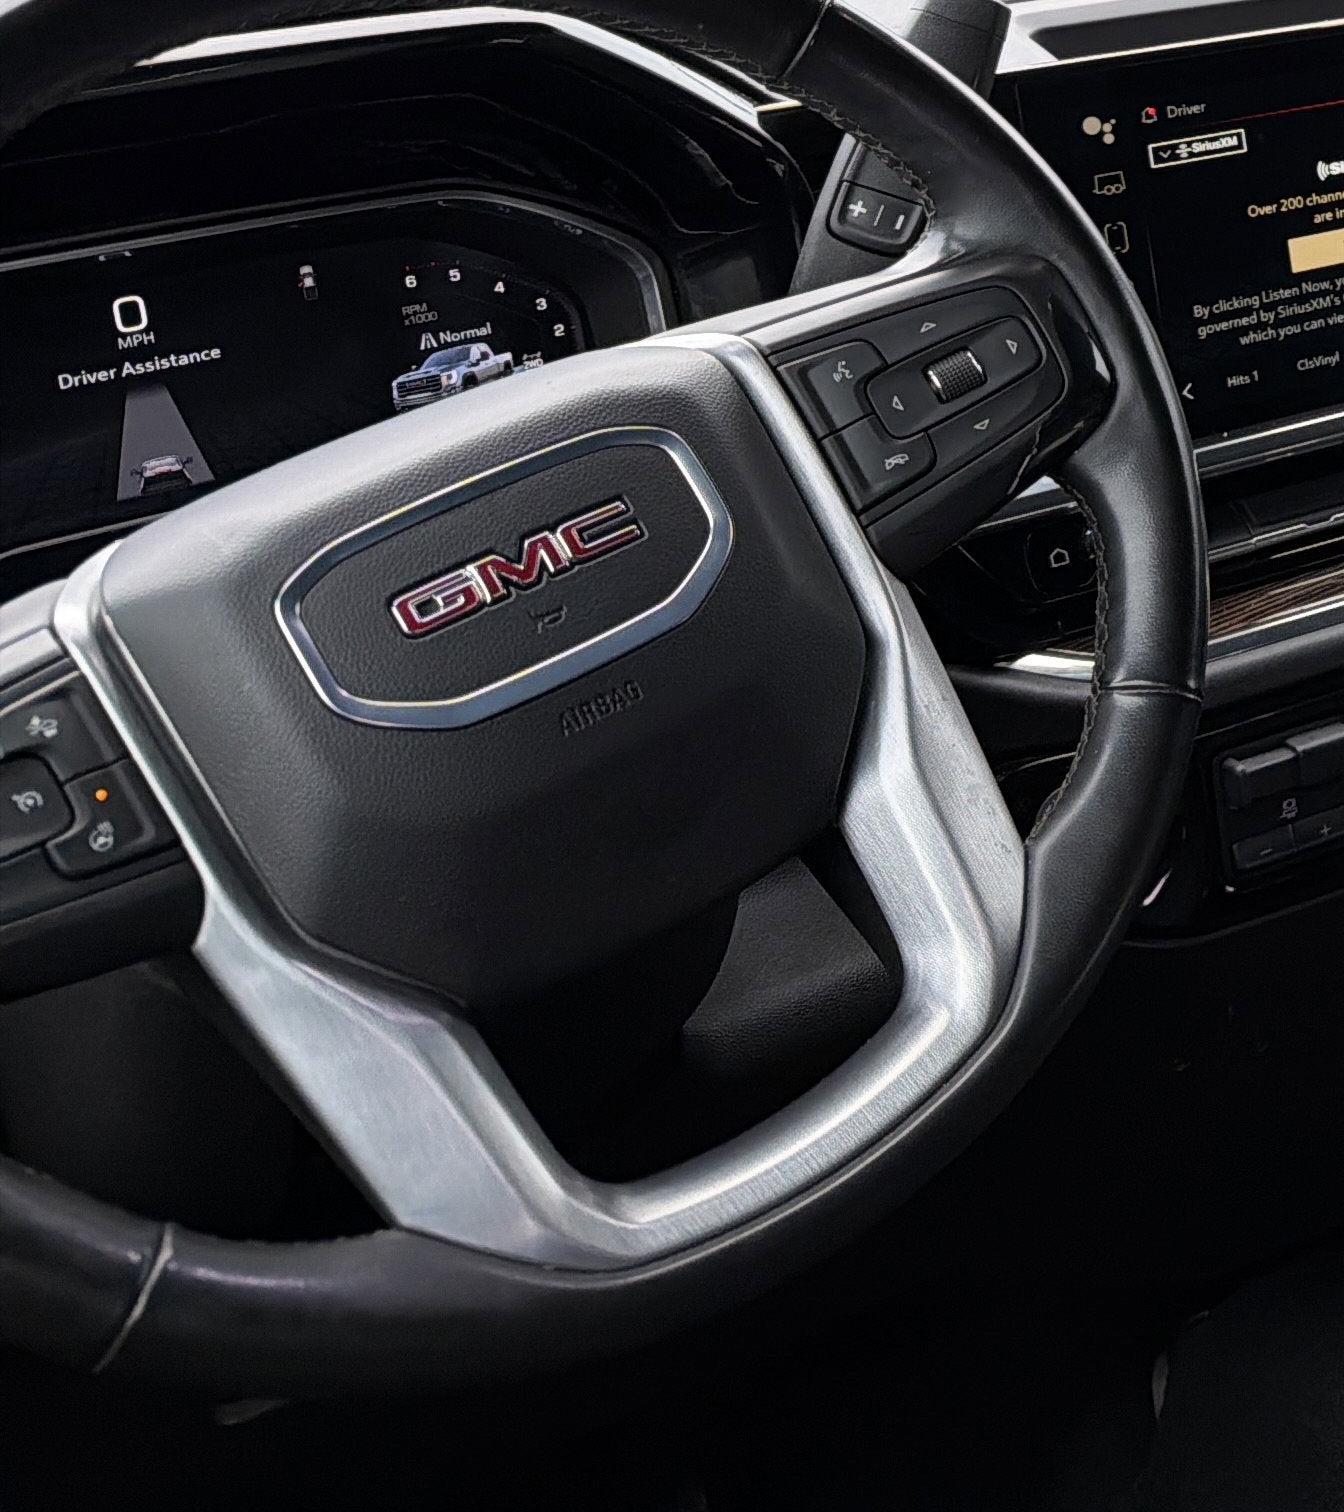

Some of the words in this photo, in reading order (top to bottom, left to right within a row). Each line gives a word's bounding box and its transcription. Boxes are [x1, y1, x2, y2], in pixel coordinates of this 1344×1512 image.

[1166, 104, 1206, 119] Driver
[1247, 202, 1277, 218] Over
[1280, 196, 1303, 212] 200
[1313, 212, 1333, 224] are
[405, 275, 417, 288] 6
[449, 269, 461, 282] 5
[494, 281, 505, 294] 4
[401, 302, 428, 316] RPM
[535, 298, 547, 311] 3
[1193, 305, 1210, 319] By
[1212, 294, 1260, 315] clicking
[1261, 287, 1299, 303] Listen
[1302, 280, 1333, 295] Now,
[112, 295, 148, 333] 0
[404, 311, 438, 326] x1000
[1197, 315, 1257, 339] governed
[1260, 311, 1276, 324] by
[1277, 295, 1341, 318] SiriusXM's
[439, 322, 493, 345] Normal
[553, 324, 565, 337] 2
[1239, 328, 1276, 346] which
[1278, 324, 1301, 340] you
[1303, 318, 1325, 331] can
[117, 331, 155, 351] MPH
[57, 366, 117, 390] Driver
[121, 347, 222, 378] Assistance
[1297, 351, 1340, 371] ClsVinyl
[1227, 374, 1250, 388] Hits
[390, 500, 641, 636] GMC
[560, 680, 645, 736] AIRBAG
